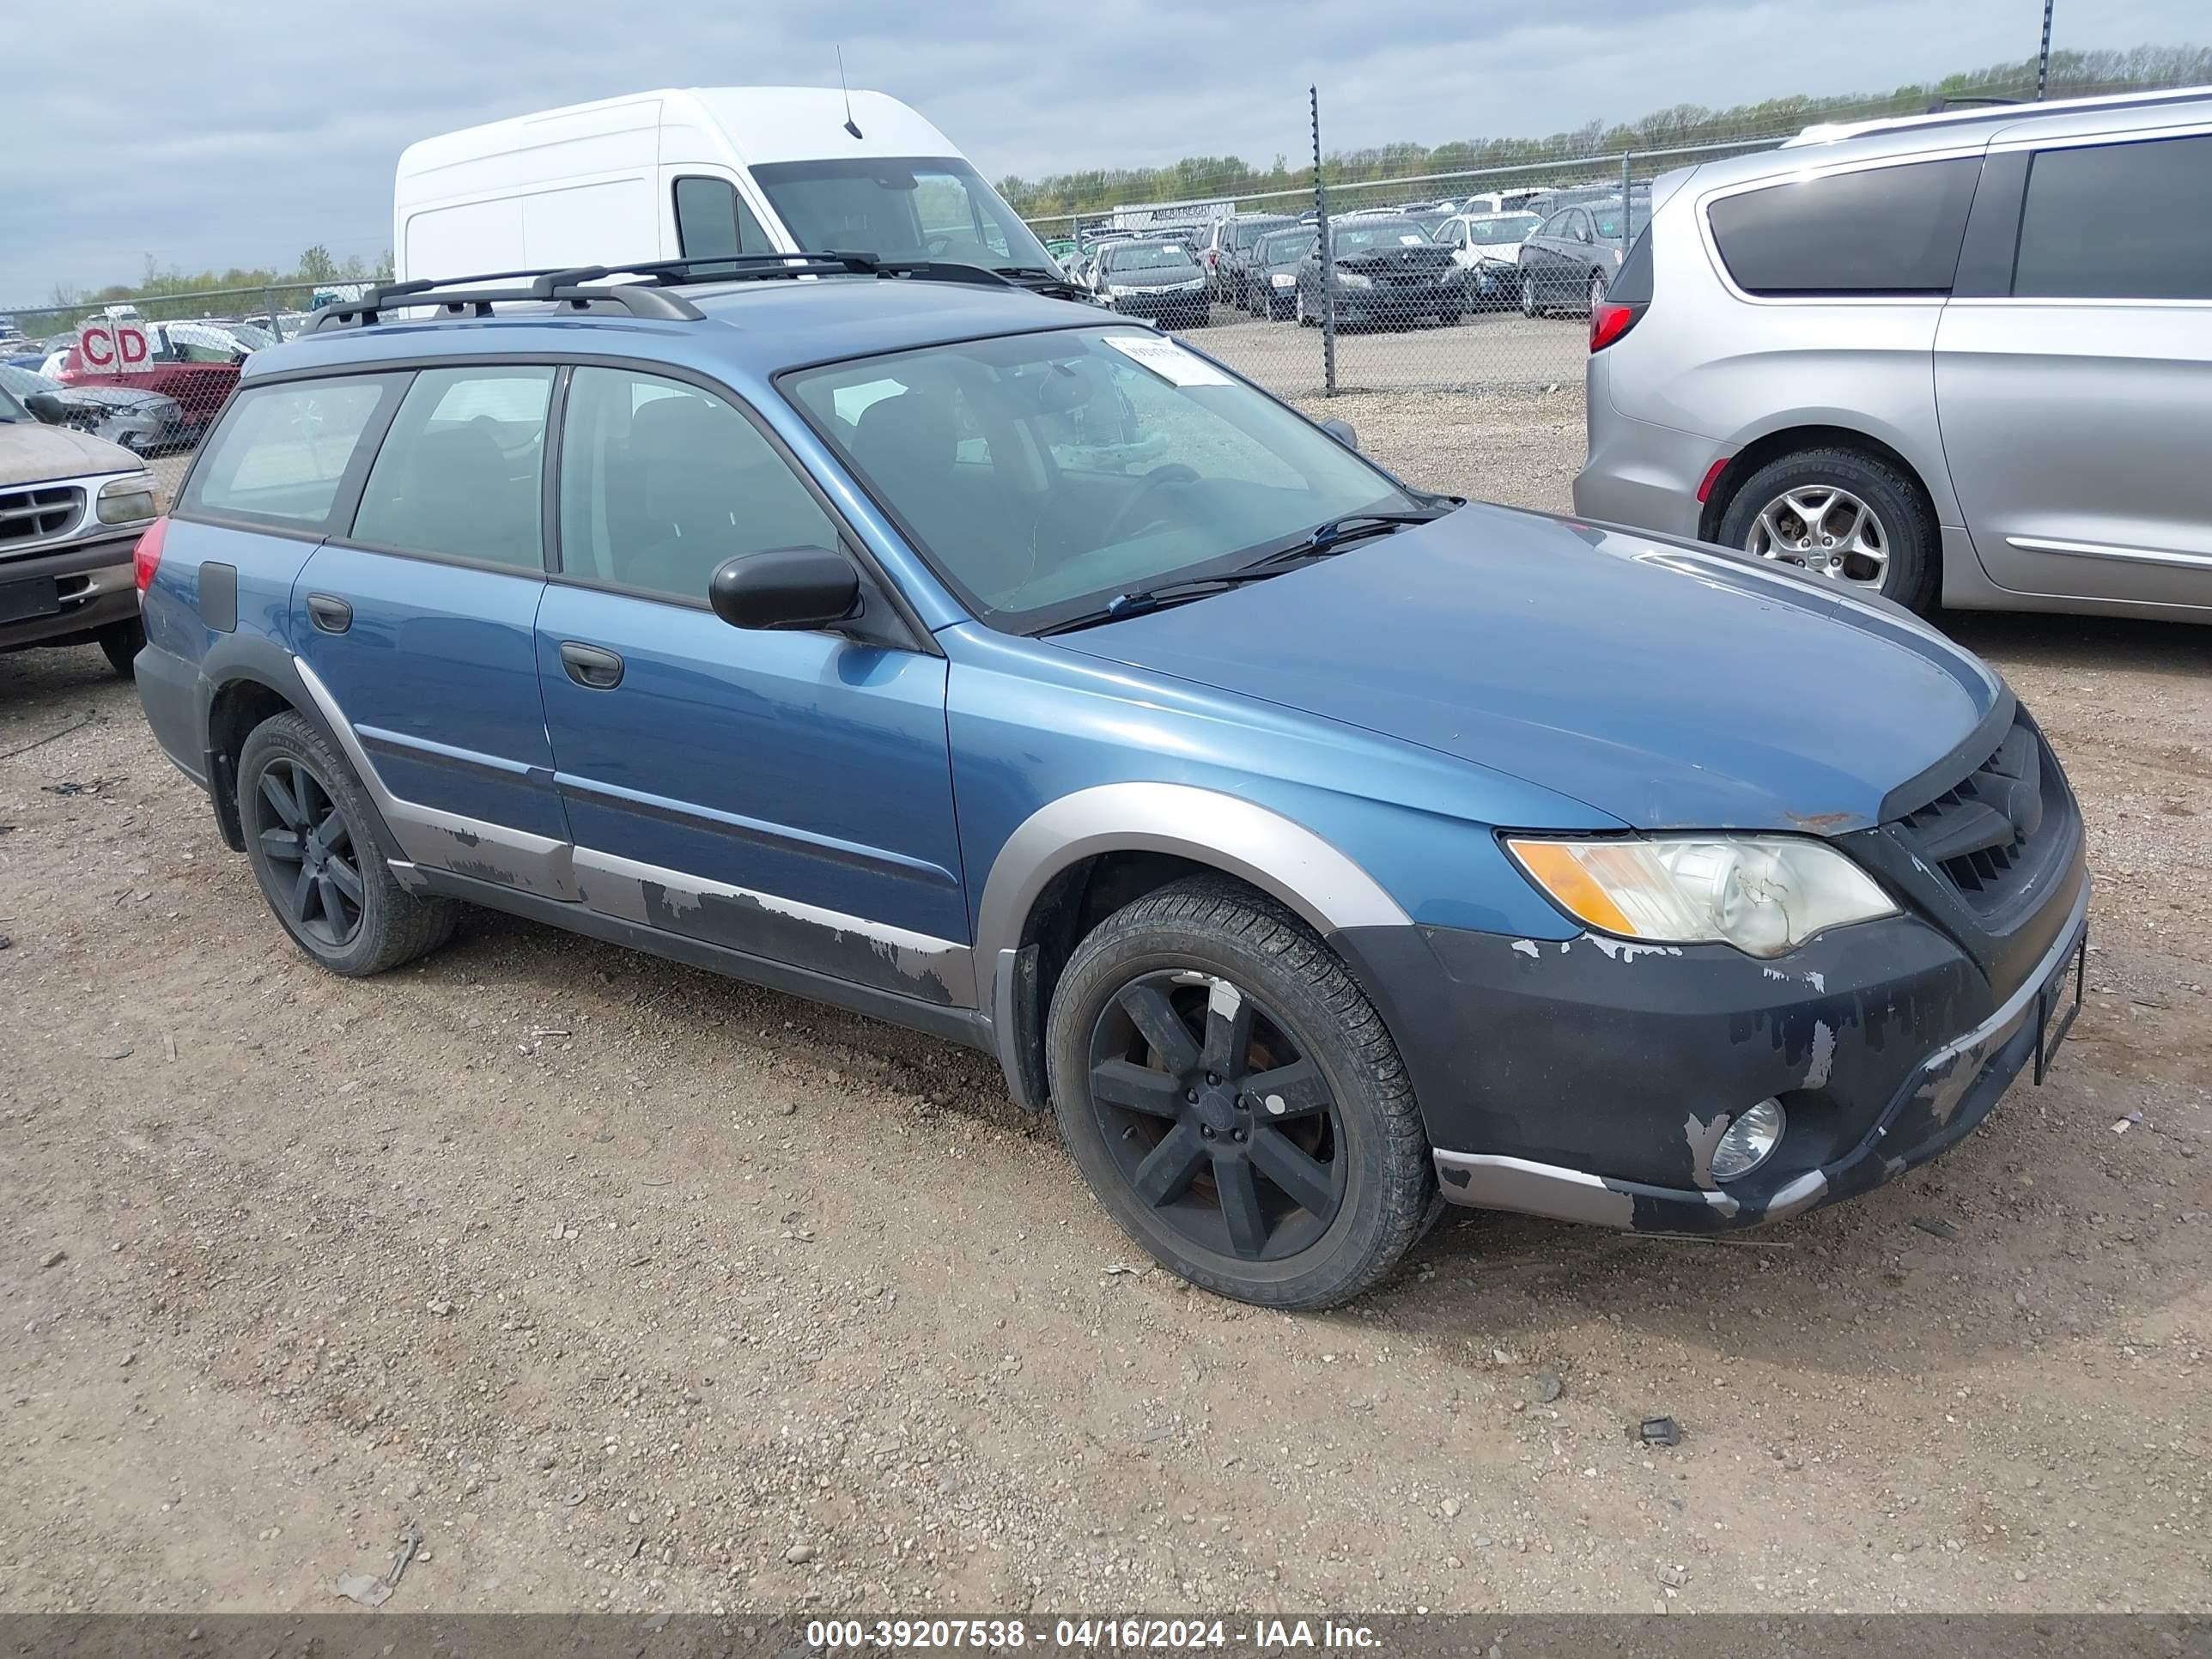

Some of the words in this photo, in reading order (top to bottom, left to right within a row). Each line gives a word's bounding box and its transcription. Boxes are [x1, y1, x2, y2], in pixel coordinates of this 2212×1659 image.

[1151, 206, 1211, 222] AMERIFREIGHT
[82, 328, 147, 366] CD
[1058, 937, 1195, 1062] GOODYEAR
